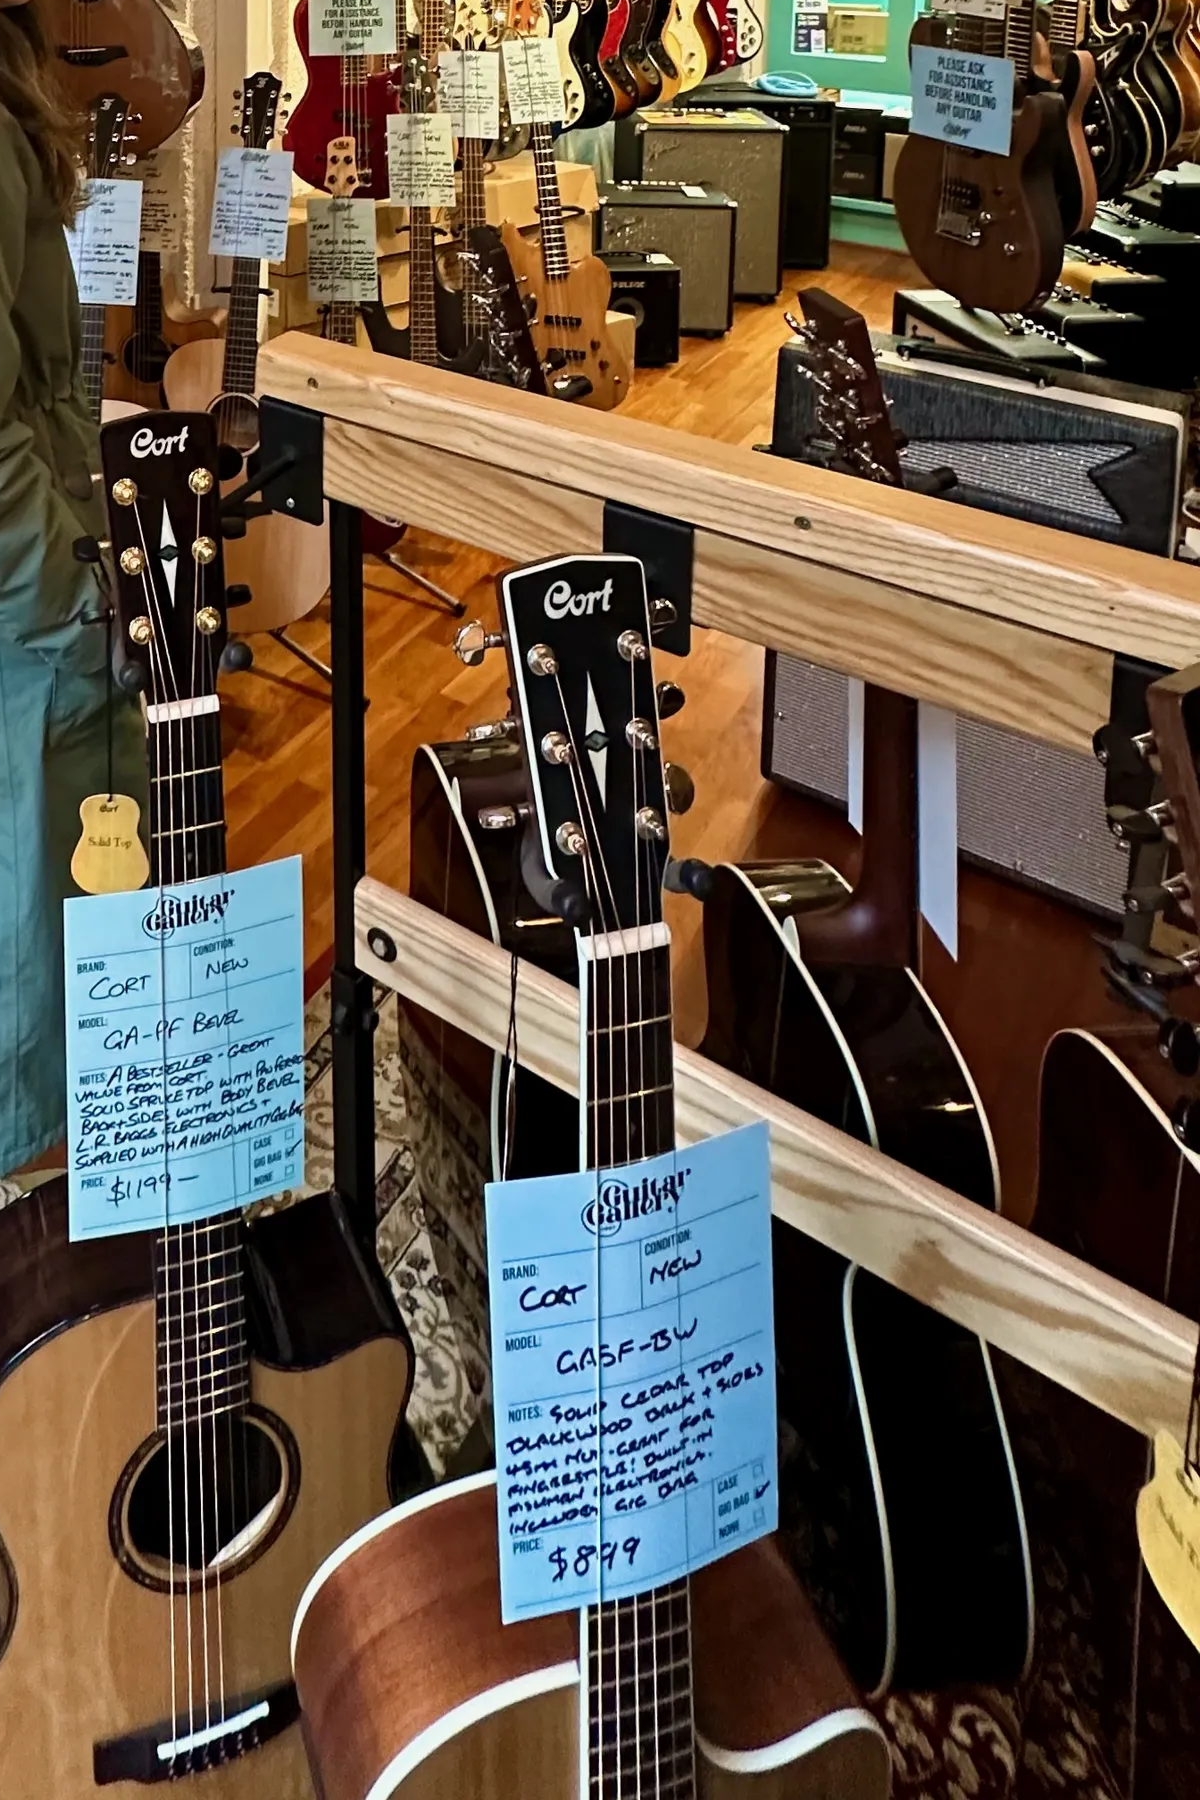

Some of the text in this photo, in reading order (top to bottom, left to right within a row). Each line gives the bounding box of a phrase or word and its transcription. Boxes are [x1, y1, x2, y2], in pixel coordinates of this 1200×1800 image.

[325, 8, 380, 18] FOR ASISTANCE
[332, 0, 357, 7] PLEASE
[349, 29, 372, 38] GUITAR
[350, 18, 383, 27] HANDLING
[938, 56, 986, 76] PLEASE ASK
[929, 70, 993, 93] FOR ASSISTANCE
[925, 84, 997, 110] BEFORE HANDLING
[936, 102, 982, 122] ANY GUITAR
[130, 425, 189, 458] Cort
[544, 578, 614, 619] Cort
[113, 837, 132, 850] Top
[161, 888, 236, 918] Guitar
[146, 902, 229, 932] Gallery
[193, 938, 235, 957] CONDITION:
[77, 960, 107, 974] BRAND:
[205, 958, 249, 980] NEW
[89, 975, 151, 1001] CORT
[78, 1018, 108, 1030] MODEL:
[193, 1009, 244, 1034] BEVEL
[79, 1073, 107, 1086] NOTES:
[107, 1066, 122, 1087] A
[227, 1037, 274, 1058] GREAT
[75, 1081, 163, 1103] VALUE FROM
[80, 1103, 124, 1120] SOLID
[127, 1089, 184, 1109] SPRUCE
[186, 1081, 214, 1097] TOP
[219, 1073, 252, 1088] WITH
[176, 1102, 212, 1118] WITH
[221, 1087, 253, 1104] BODY
[257, 1073, 300, 1094] BEVEL
[114, 1125, 157, 1143] BAGGS
[164, 1100, 258, 1134] ELECTRONICS
[75, 1147, 137, 1170] SUPPLIED
[142, 1141, 175, 1158] WITH
[177, 1137, 188, 1149] A
[190, 1130, 222, 1148] HIGH
[222, 1112, 271, 1138] QUALITY
[254, 1135, 272, 1149] CASE
[254, 1150, 282, 1169] GIG BAG
[81, 1177, 107, 1190] PRICE:
[603, 1168, 692, 1209] Guitar
[586, 1188, 683, 1226] Gallery
[644, 1228, 692, 1256] CONDITION:
[502, 1264, 539, 1281] BRAND:
[650, 1249, 701, 1285] NEW
[519, 1283, 587, 1312] CORT
[505, 1335, 542, 1352] MODEL:
[508, 1352, 734, 1424] NOTES: SOLID CEDAR TOP
[506, 1362, 764, 1455] BLACKWOOD BACK SIDES
[679, 1408, 715, 1432] FOR
[658, 1471, 698, 1498] BAG
[717, 1474, 738, 1494] CASE
[508, 1488, 584, 1517] FISHMAN
[733, 1493, 750, 1512] BAG
[512, 1536, 640, 1582] PRICE: $899
